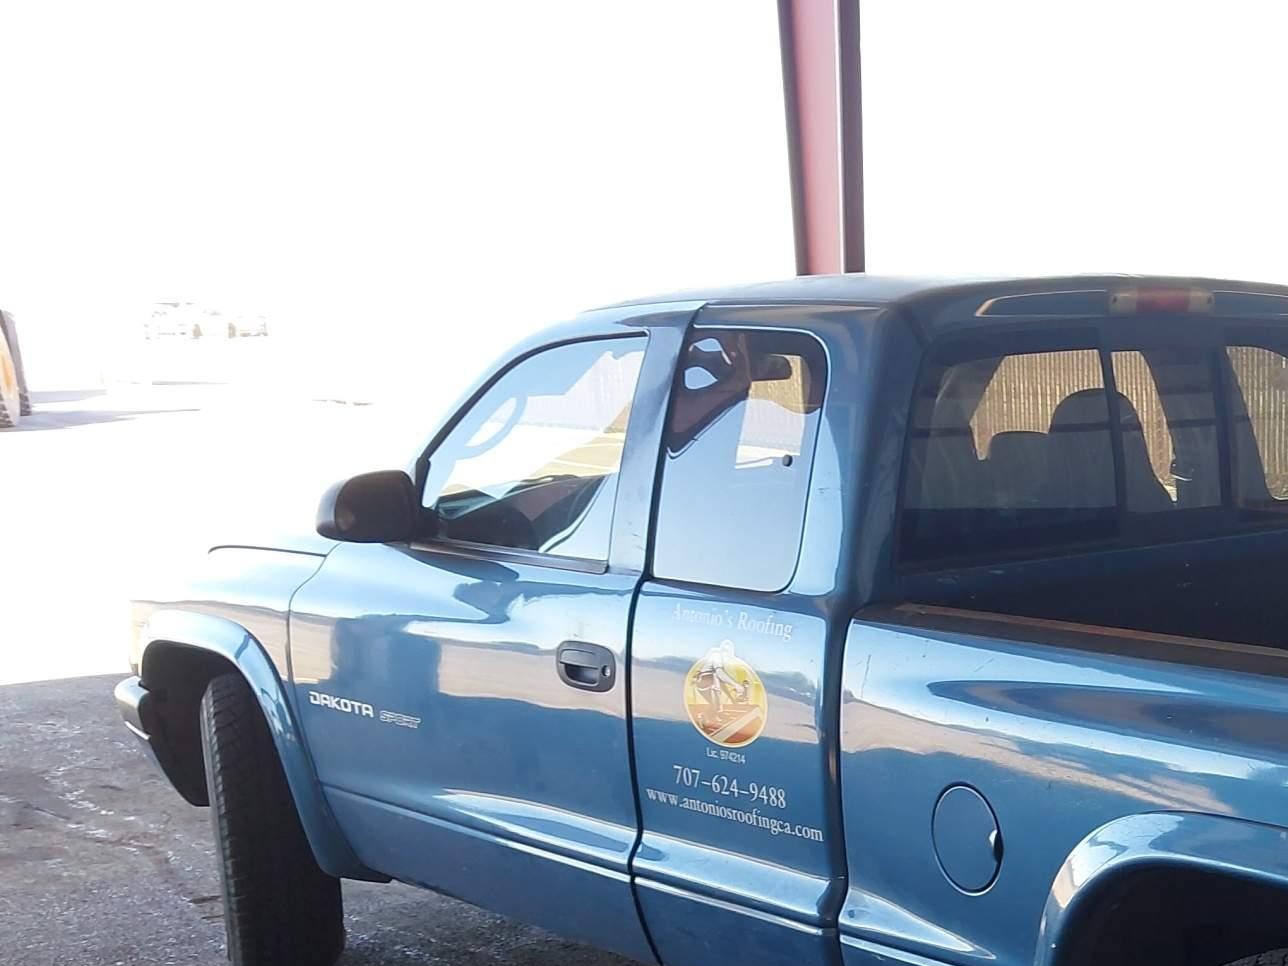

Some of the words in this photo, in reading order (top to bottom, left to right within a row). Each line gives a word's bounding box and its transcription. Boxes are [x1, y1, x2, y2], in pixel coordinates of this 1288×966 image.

[737, 612, 793, 641] Roofing
[309, 691, 374, 718] DAKOTA
[380, 710, 421, 728] SPORT
[673, 765, 786, 808] 707-624-9488
[646, 787, 824, 842] www.antoniosroofingca.com
